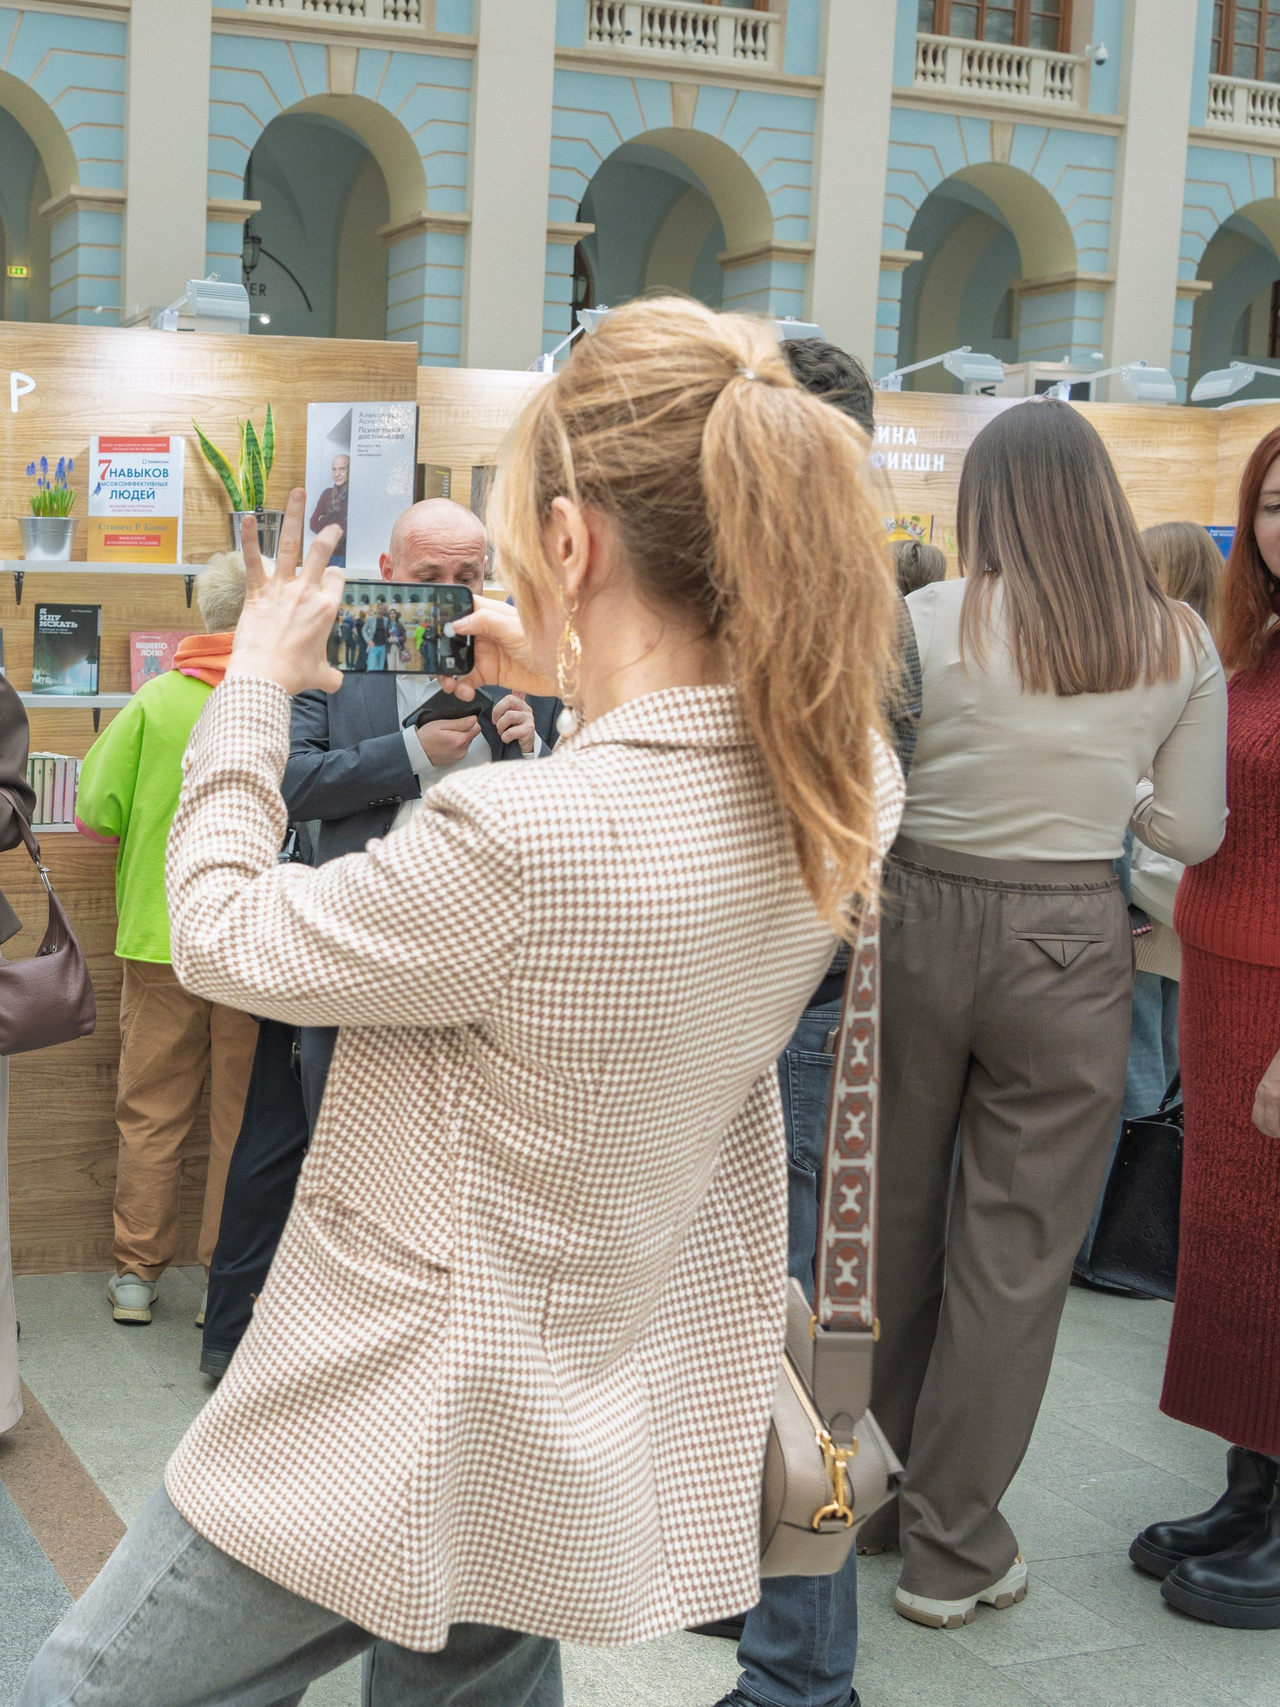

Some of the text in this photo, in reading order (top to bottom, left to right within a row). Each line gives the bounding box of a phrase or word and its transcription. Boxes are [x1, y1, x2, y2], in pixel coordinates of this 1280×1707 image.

[877, 425, 917, 446] ИНА
[98, 459, 169, 481] 7 НАВЫКОВ
[109, 488, 156, 501] ЛЮДЕЙ
[98, 522, 132, 531] Стивен
[144, 523, 168, 531] Кови
[39, 607, 47, 615] Я
[39, 620, 78, 628] ИСКАТЬ
